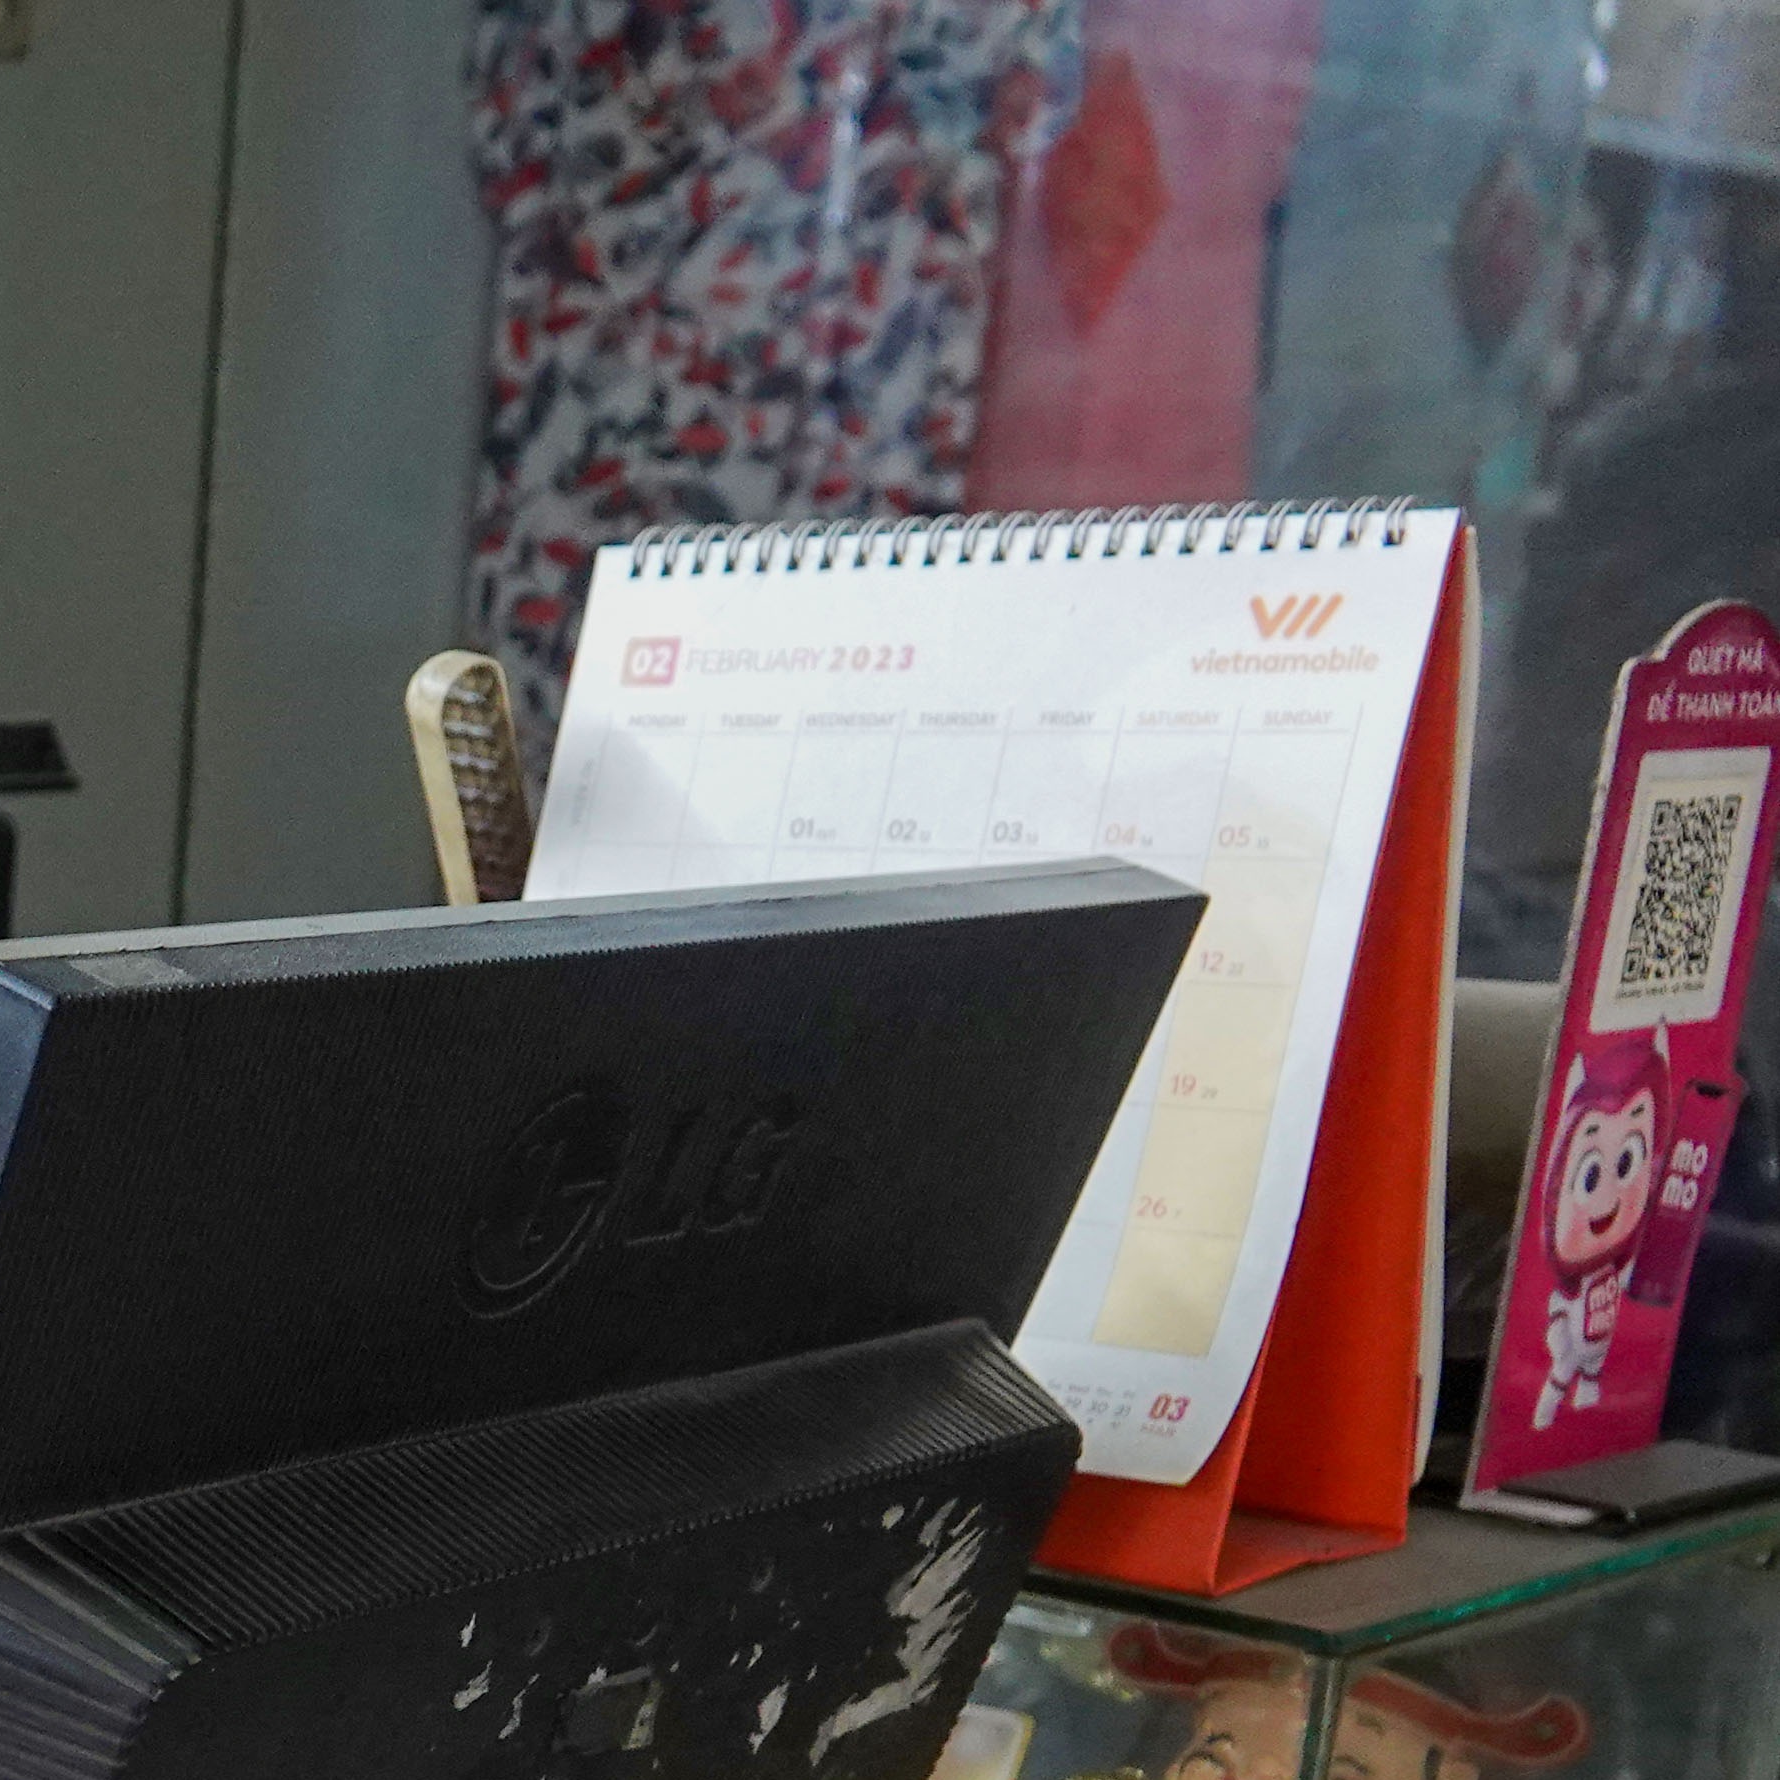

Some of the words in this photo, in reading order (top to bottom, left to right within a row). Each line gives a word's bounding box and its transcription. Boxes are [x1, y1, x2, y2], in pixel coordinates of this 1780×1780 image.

[630, 644, 673, 676] 02
[686, 648, 824, 674] FEBRUARY
[827, 644, 916, 672] 2023
[1191, 644, 1380, 674] vietnamobile
[1678, 690, 1736, 720] THANH
[627, 714, 688, 728] MONDAY
[720, 713, 783, 728] TUESDAY
[805, 713, 896, 727] WEDNESDAY
[919, 711, 998, 728] THURSDAY
[1040, 710, 1096, 727] FRIDAY
[1136, 710, 1221, 727] SATURDAY
[1262, 709, 1333, 726] SUNDAY
[789, 817, 815, 839] 01
[888, 818, 918, 841] 02
[992, 820, 1023, 844] 03
[1104, 823, 1137, 846] 04
[1217, 825, 1251, 849] 05
[1198, 951, 1224, 974] 12
[1169, 1073, 1197, 1098] 19
[1136, 1197, 1167, 1220] 26
[1148, 1392, 1192, 1422] 03
